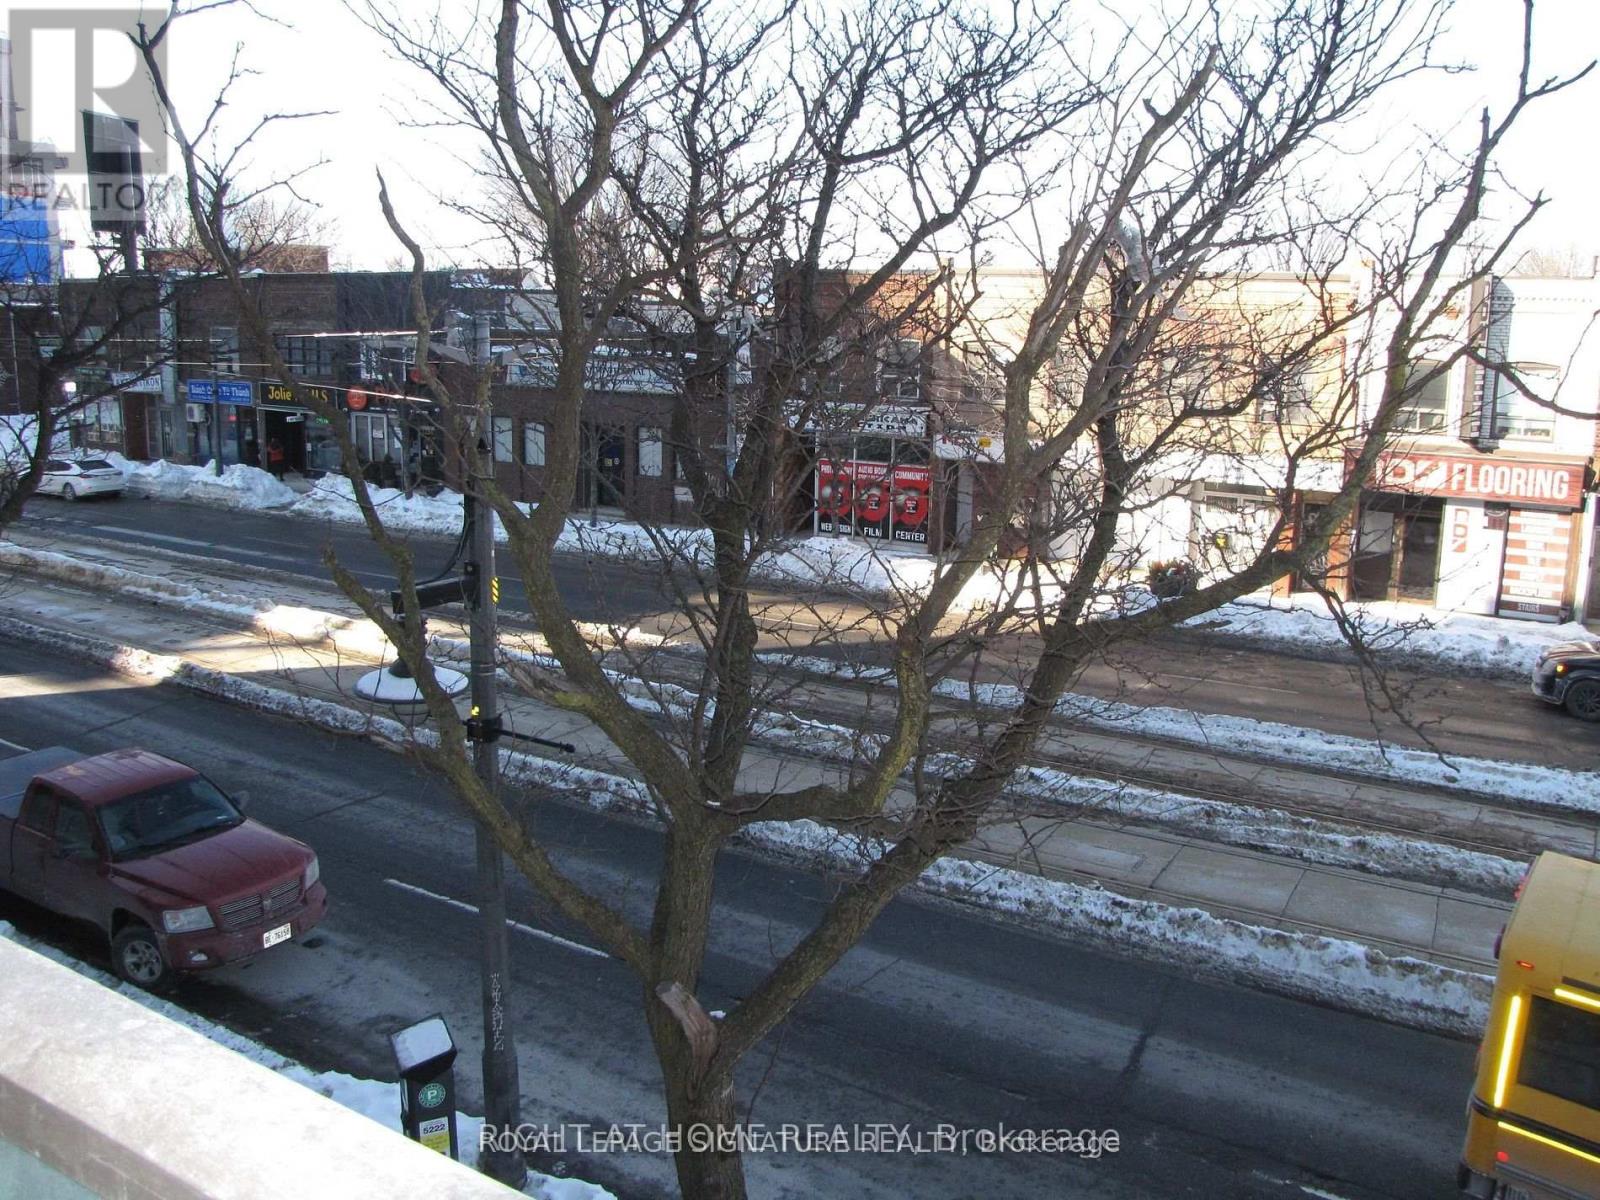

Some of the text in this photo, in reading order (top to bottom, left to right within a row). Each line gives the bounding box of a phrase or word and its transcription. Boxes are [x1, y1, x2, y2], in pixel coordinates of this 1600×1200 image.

[268, 385, 292, 401] Jolie
[894, 470, 929, 482] COMMUNITY
[1451, 463, 1570, 500] FLOORING
[863, 527, 882, 537] FILM
[895, 530, 925, 542] CENTER
[423, 1123, 446, 1135] 5222
